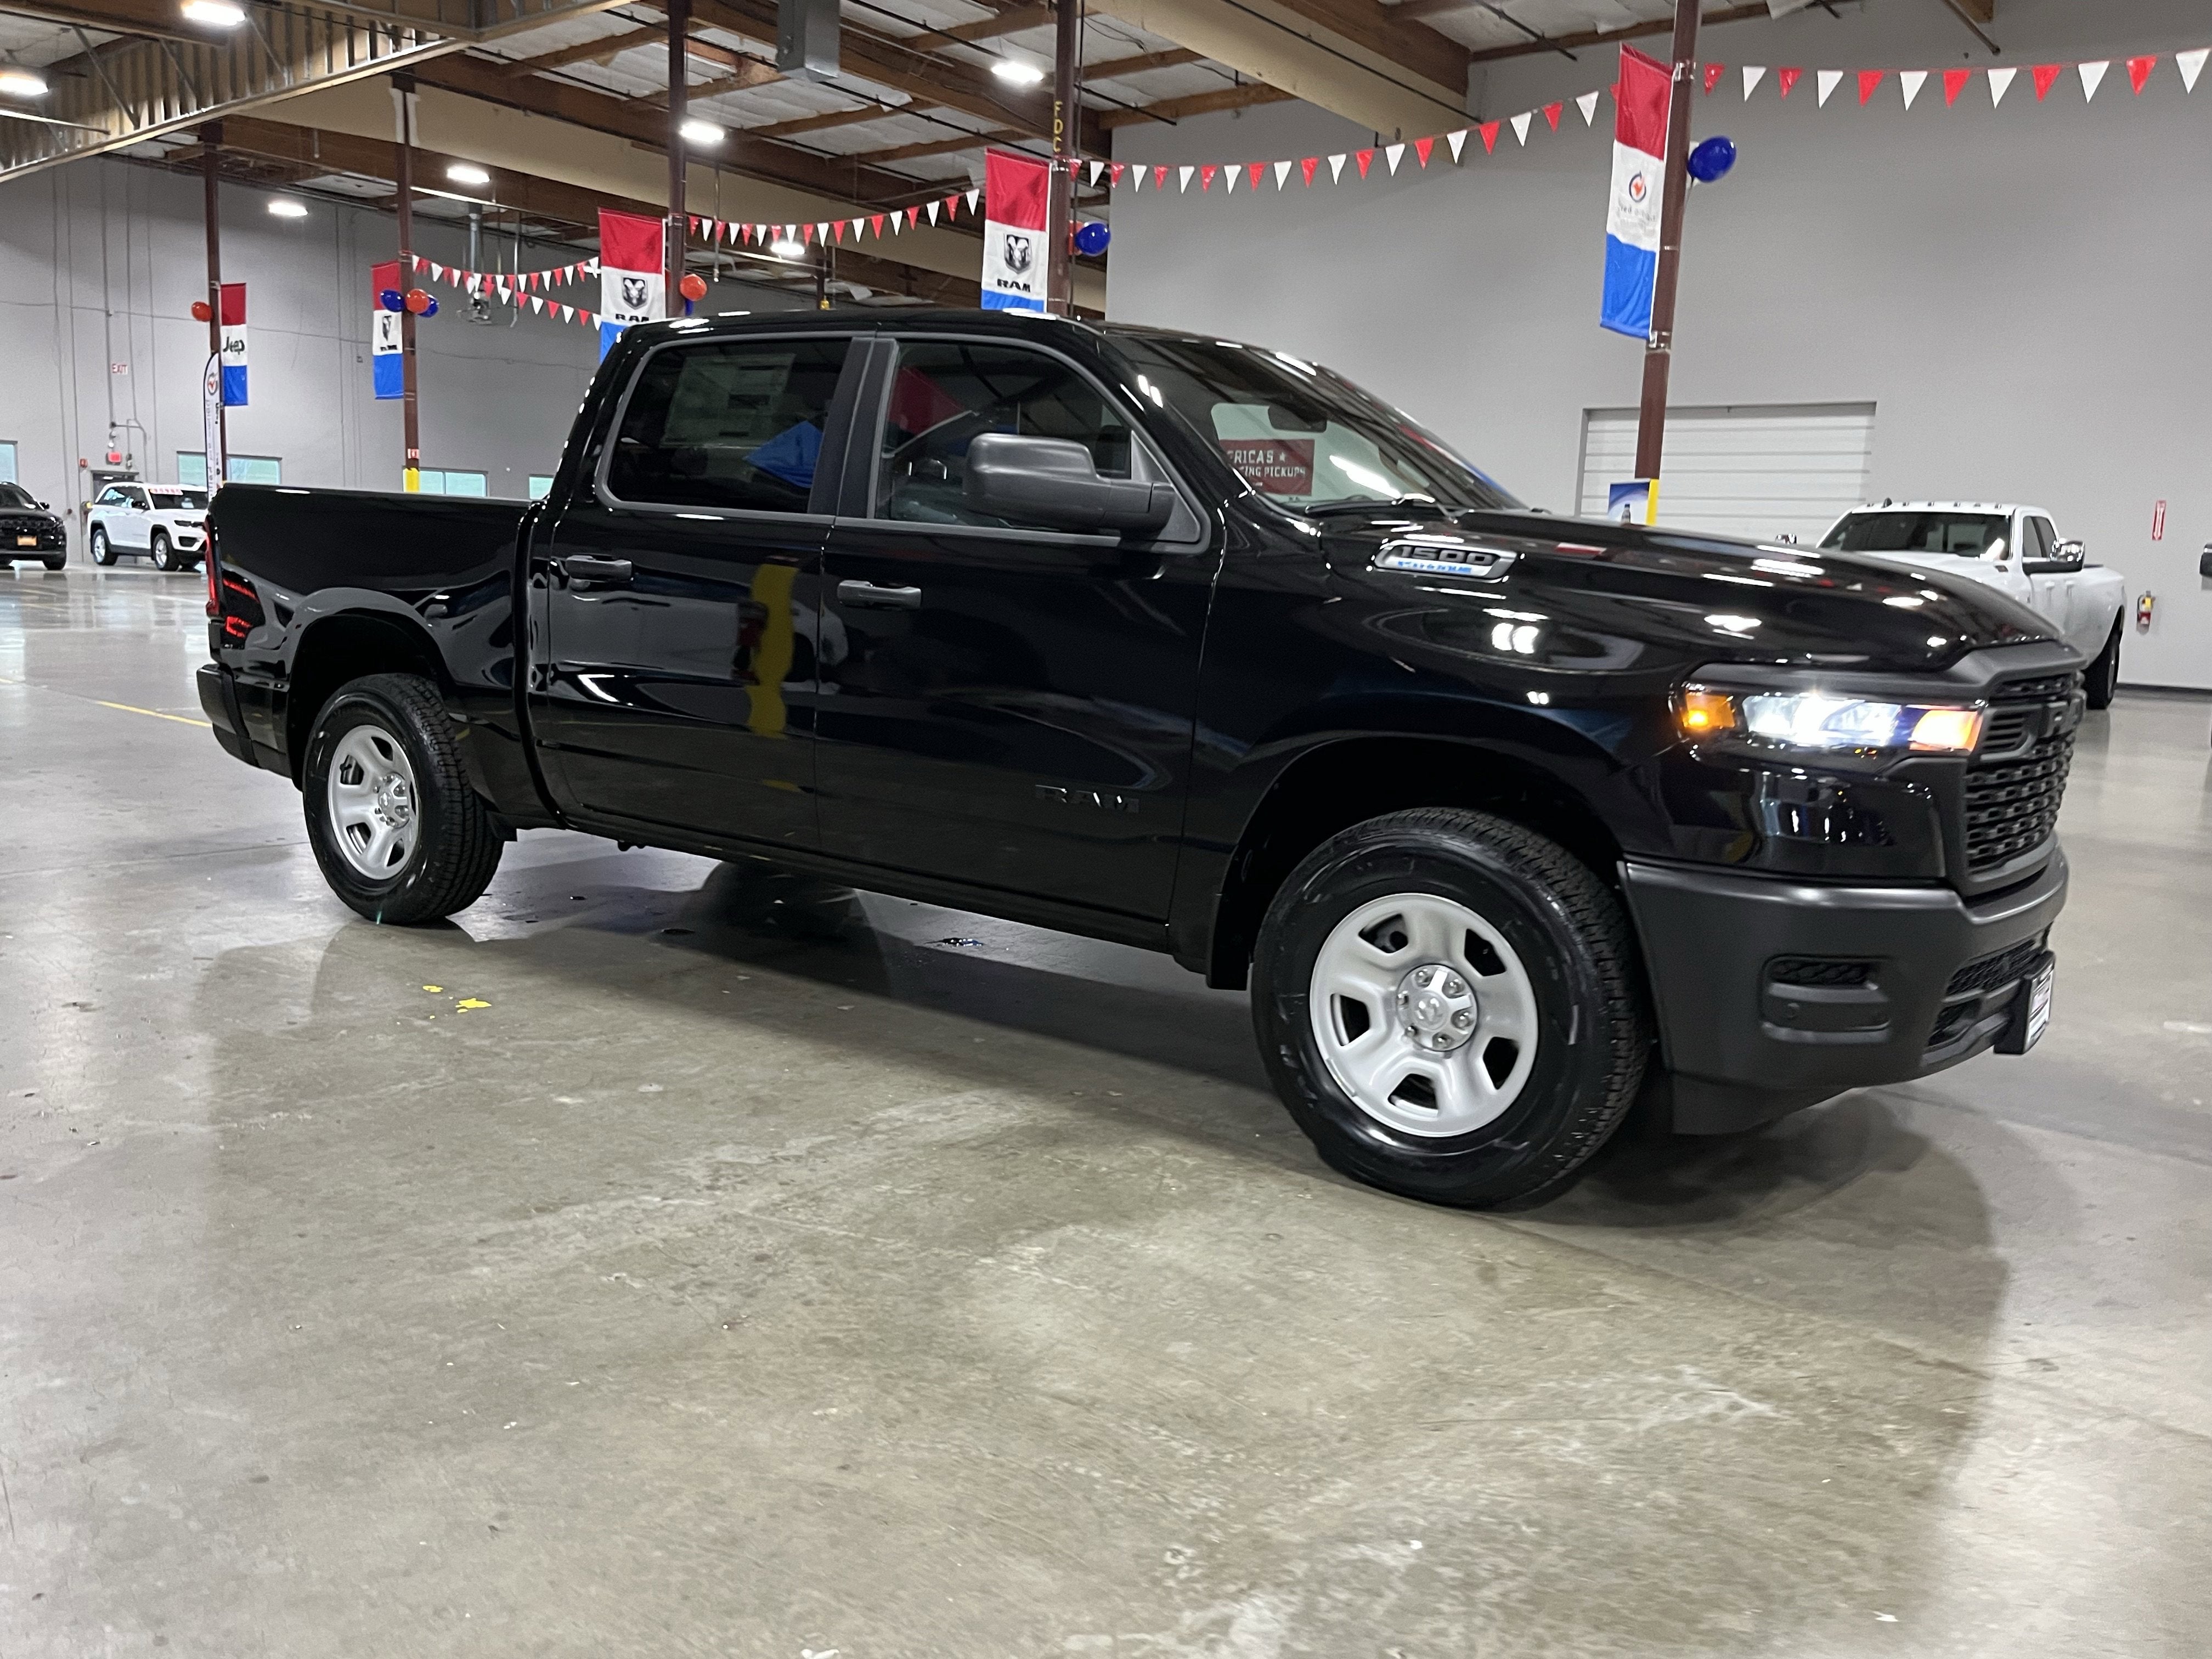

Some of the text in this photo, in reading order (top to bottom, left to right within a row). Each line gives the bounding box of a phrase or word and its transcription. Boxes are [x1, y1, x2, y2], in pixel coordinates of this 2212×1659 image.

[997, 278, 1030, 293] RAM
[223, 336, 245, 356] Jeep
[111, 363, 127, 374] EXIT
[1239, 465, 1261, 477] ING
[1401, 546, 1493, 565] 1500
